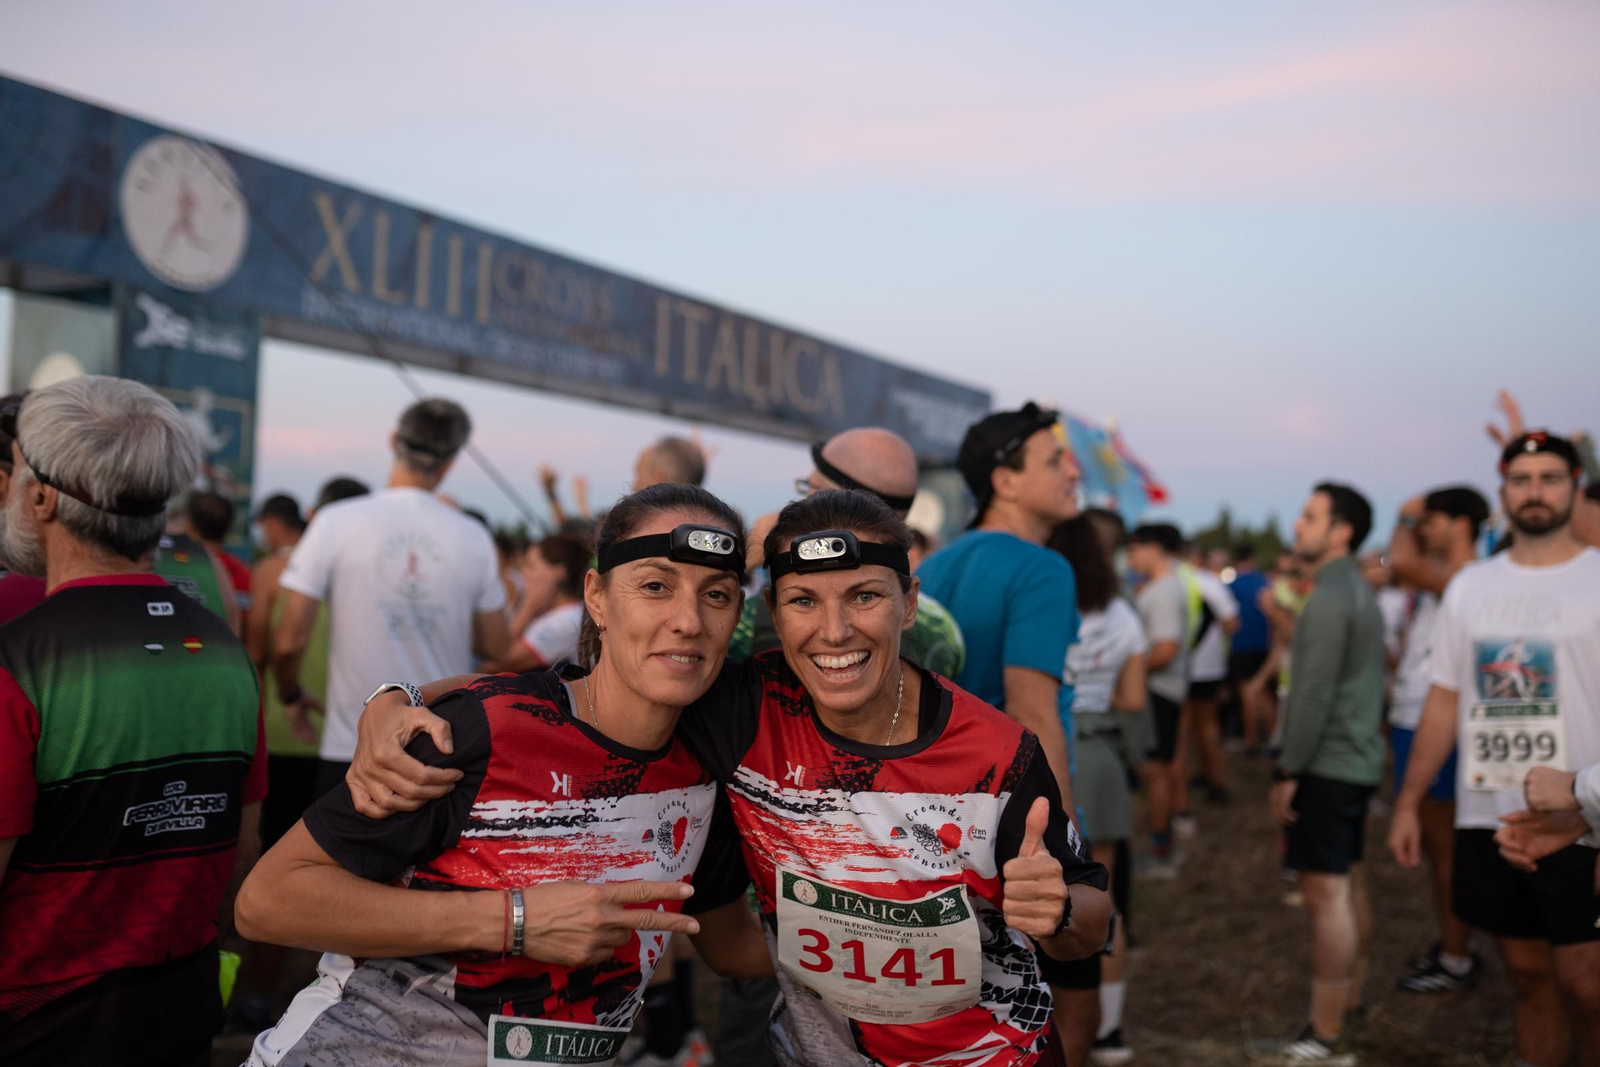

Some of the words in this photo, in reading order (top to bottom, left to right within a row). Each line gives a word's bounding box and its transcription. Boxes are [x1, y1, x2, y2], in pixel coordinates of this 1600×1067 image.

[1475, 730, 1556, 764] 3999
[831, 892, 924, 923] ITÁLICA
[819, 914, 851, 929] ESTHER
[851, 922, 901, 937] FERNANDEZ
[844, 928, 912, 945] INDEPENDIENTE
[797, 928, 966, 987] 3141
[544, 1031, 615, 1057] ITÁLICA
